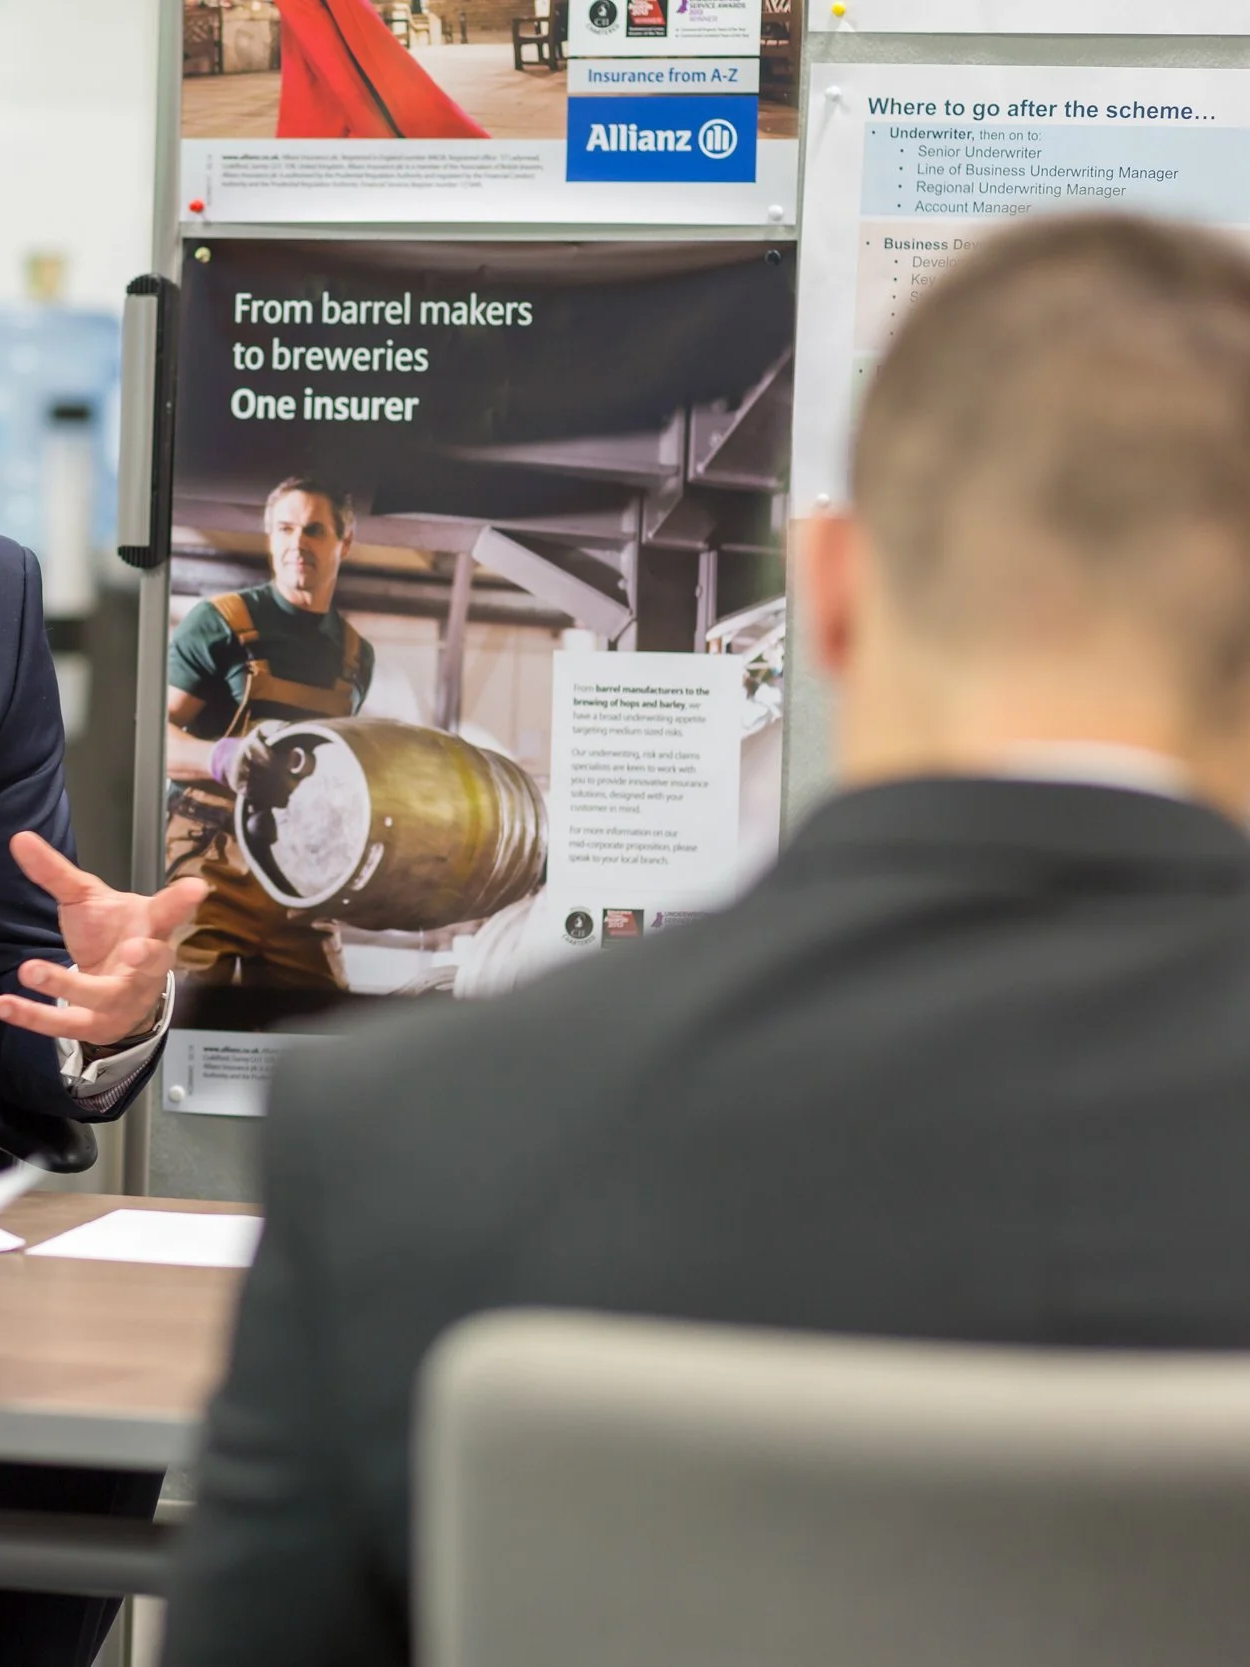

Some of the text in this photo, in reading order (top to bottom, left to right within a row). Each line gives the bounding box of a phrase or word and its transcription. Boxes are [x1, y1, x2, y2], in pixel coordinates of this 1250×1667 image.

[588, 67, 739, 83] Insurance from A-Z
[868, 97, 937, 116] Where
[944, 100, 965, 116] to
[973, 102, 1000, 121] go
[1007, 99, 1057, 117] after
[1065, 100, 1099, 118] the
[585, 122, 693, 152] Allianz
[889, 127, 1042, 141] Underwriter, then on to:
[918, 144, 1042, 159] Senior Underwriter
[917, 163, 1179, 182] Line of Business Underwriting Manager
[916, 181, 1127, 199] Regional Underwriting Manager
[915, 200, 1032, 216] Account Manager
[884, 237, 948, 250] Business
[911, 273, 937, 288] Key
[234, 291, 533, 326] From barrel makers
[232, 337, 429, 372] to breweries
[230, 387, 419, 421] One insurer
[573, 684, 594, 693] From
[596, 685, 620, 693] barrel
[622, 686, 683, 695] manufacturers
[696, 687, 710, 695] the
[573, 698, 608, 708] brewing
[610, 699, 618, 707] of
[620, 700, 640, 709] hops
[642, 700, 657, 708] and
[599, 712, 621, 720] broad
[623, 714, 673, 724] underwriting
[675, 715, 706, 723] appetite
[572, 726, 607, 735] targeting
[609, 727, 642, 735] medium
[644, 728, 663, 736] sized
[571, 748, 586, 756] Our
[658, 751, 673, 759] and
[675, 751, 700, 760] claims
[627, 763, 645, 772] keen
[657, 765, 676, 773] work
[678, 765, 696, 773] with
[571, 777, 585, 785] you
[597, 777, 627, 786] provide
[629, 778, 668, 787] innovative
[671, 780, 709, 788] insurance
[609, 791, 645, 801] designed
[647, 792, 664, 800] with
[666, 793, 683, 803] your
[569, 826, 581, 834] For
[673, 842, 698, 853] please
